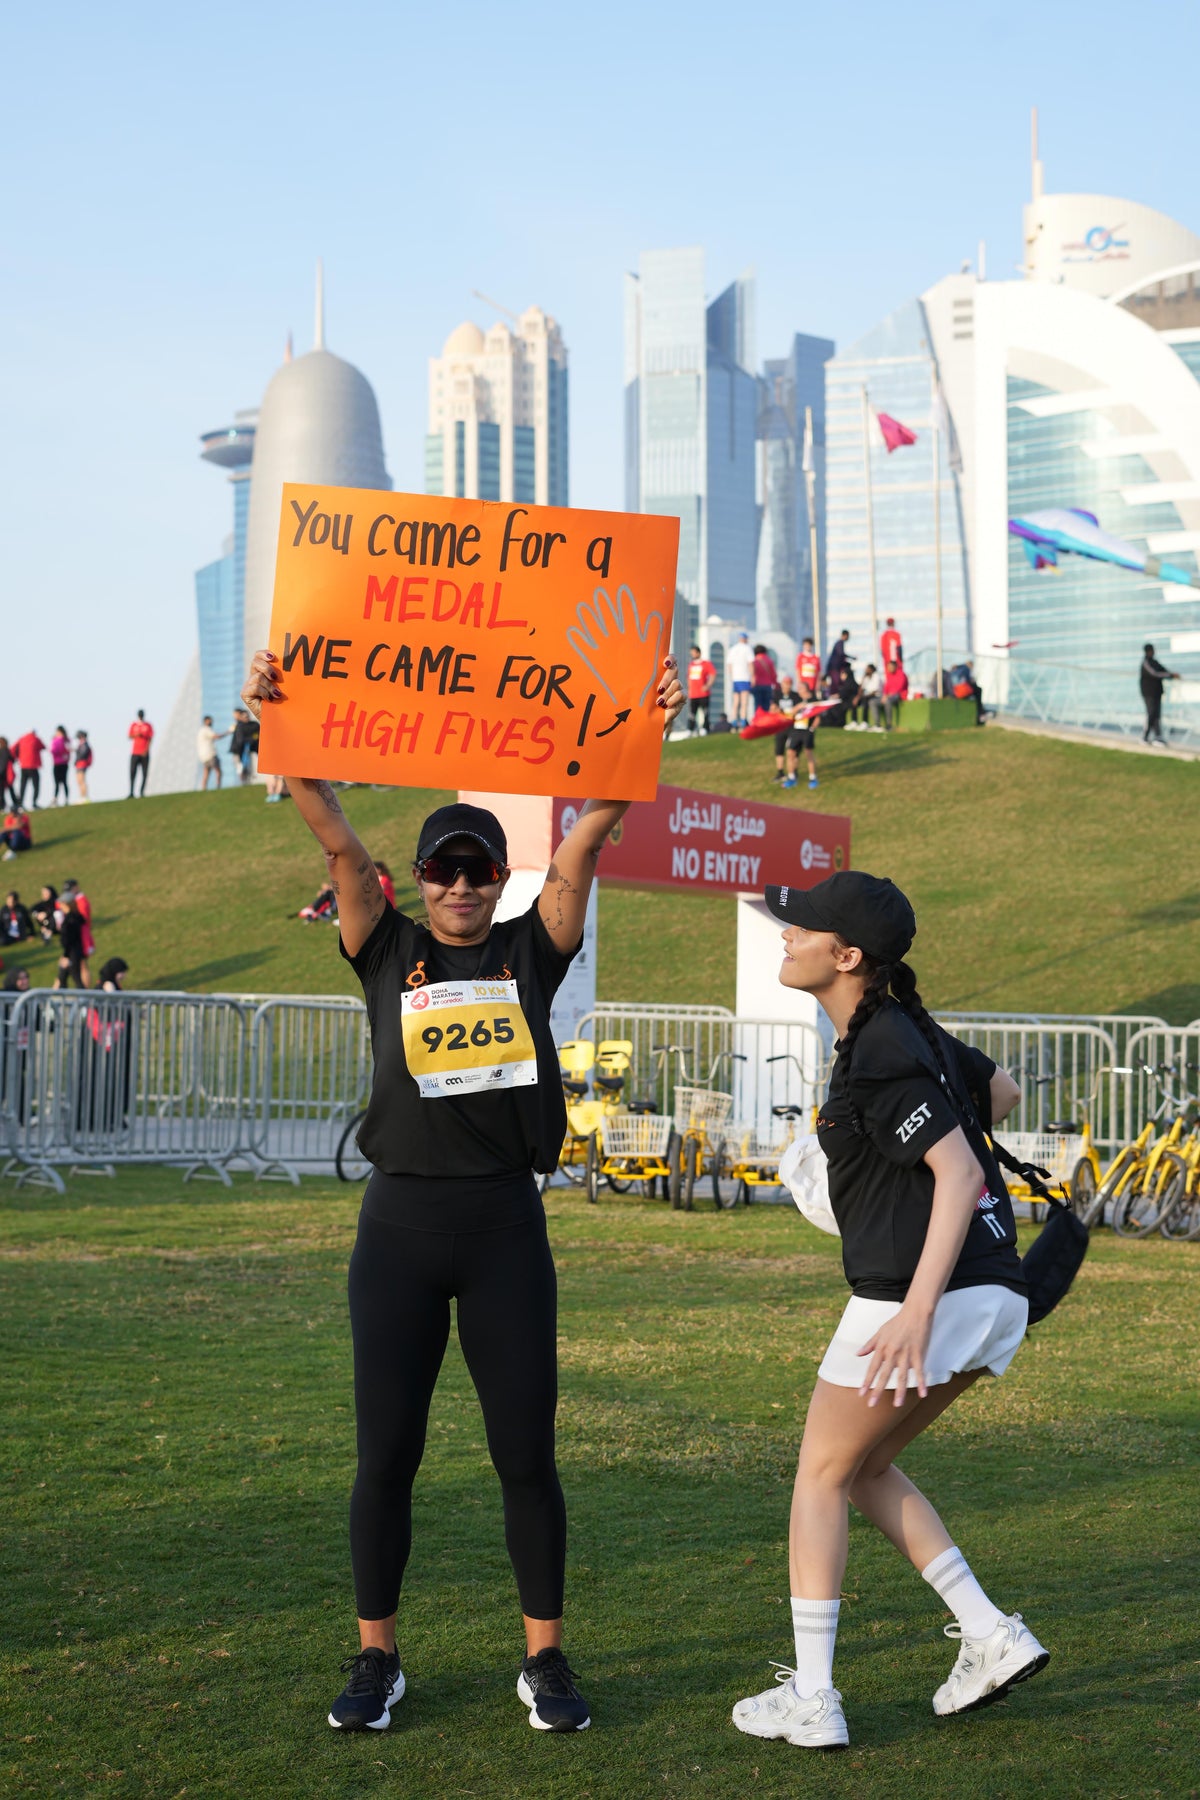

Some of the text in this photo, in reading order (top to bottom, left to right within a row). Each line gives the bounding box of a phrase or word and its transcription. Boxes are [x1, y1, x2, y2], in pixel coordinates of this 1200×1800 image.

[290, 499, 613, 578] You came for a
[282, 632, 575, 710] WE CAME FOR
[321, 700, 424, 757] HIGH
[669, 797, 767, 845] ممنوع الدخول
[672, 846, 761, 885] NO ENTRY
[431, 991, 463, 999] MARATHON
[473, 986, 507, 997] 10 KM
[422, 1017, 515, 1053] 9265
[895, 1102, 932, 1143] ZEST
[982, 1213, 1006, 1239] IT
